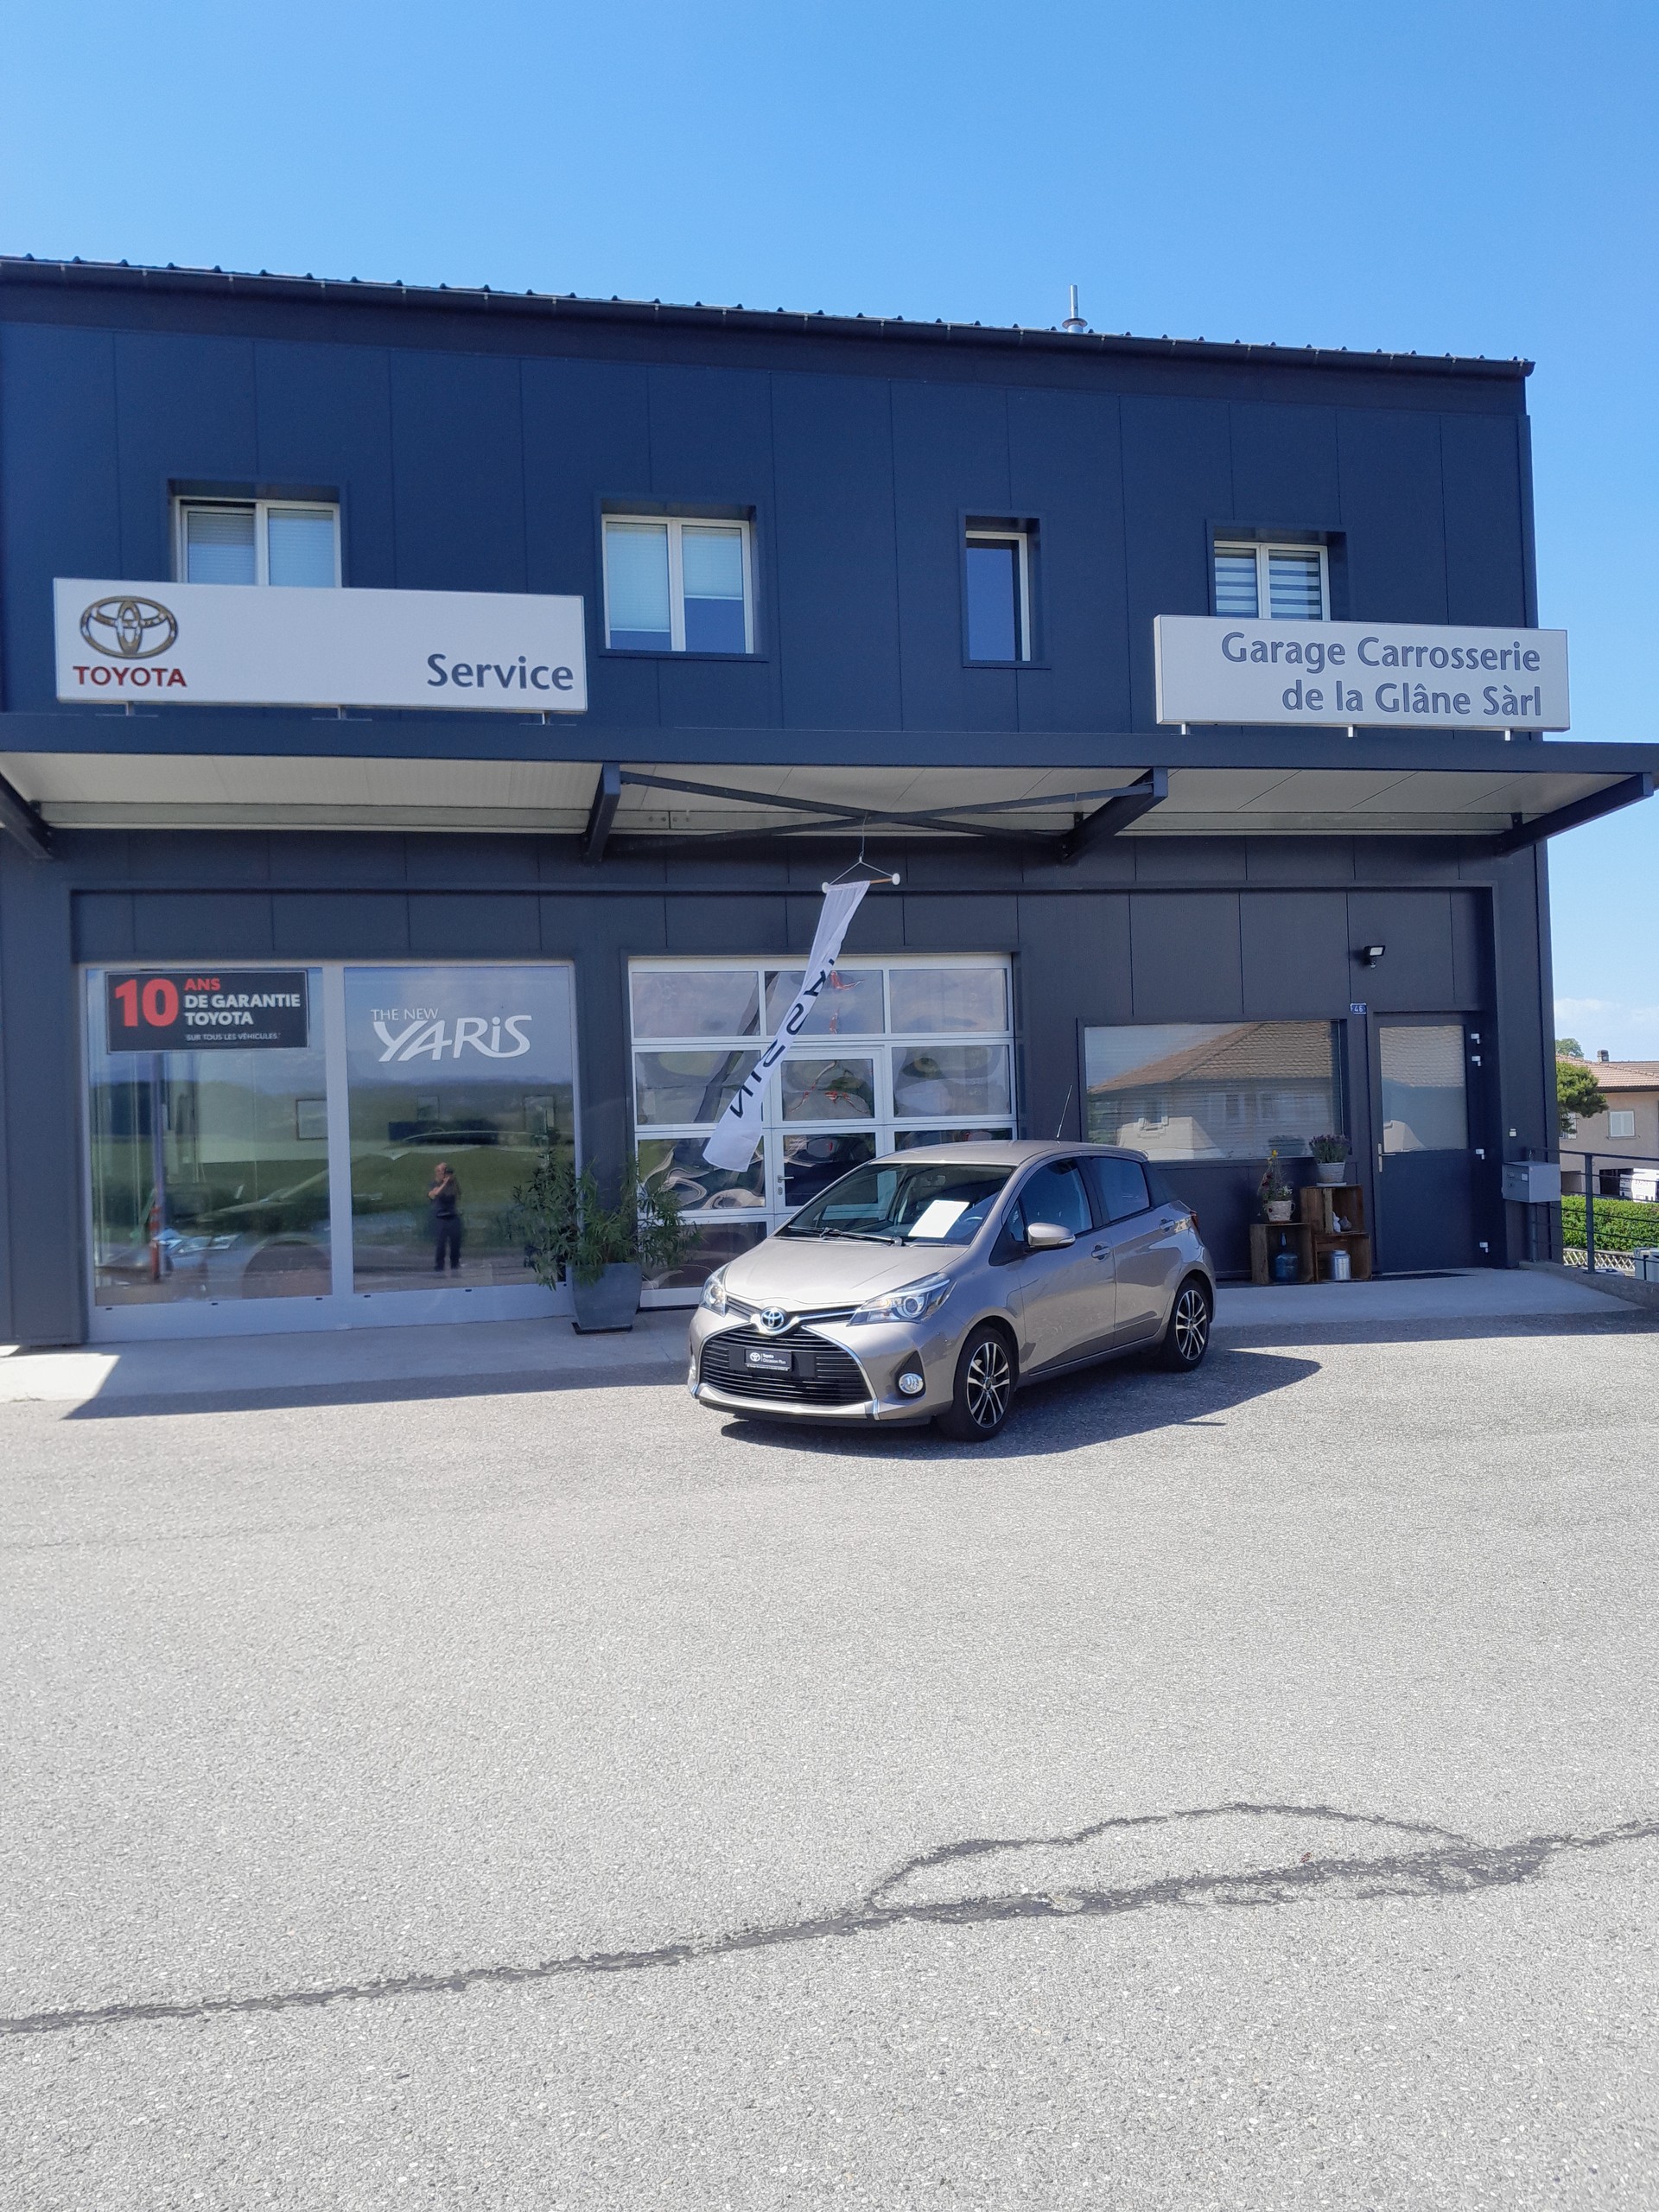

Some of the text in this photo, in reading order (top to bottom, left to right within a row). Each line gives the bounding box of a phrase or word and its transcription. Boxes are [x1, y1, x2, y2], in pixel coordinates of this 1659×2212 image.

[1221, 632, 1541, 674] Garage Carrosserie
[73, 665, 188, 688] TOYOTA
[427, 653, 575, 691] Service
[1281, 679, 1541, 716] de la Glâne Sàrl
[184, 977, 221, 991] ANS
[114, 978, 179, 1027] 10
[184, 993, 301, 1008] DE GARANTIE
[184, 1011, 254, 1026] TOYOTA
[370, 1007, 439, 1021] THE NEW
[203, 1033, 222, 1041] TOUS
